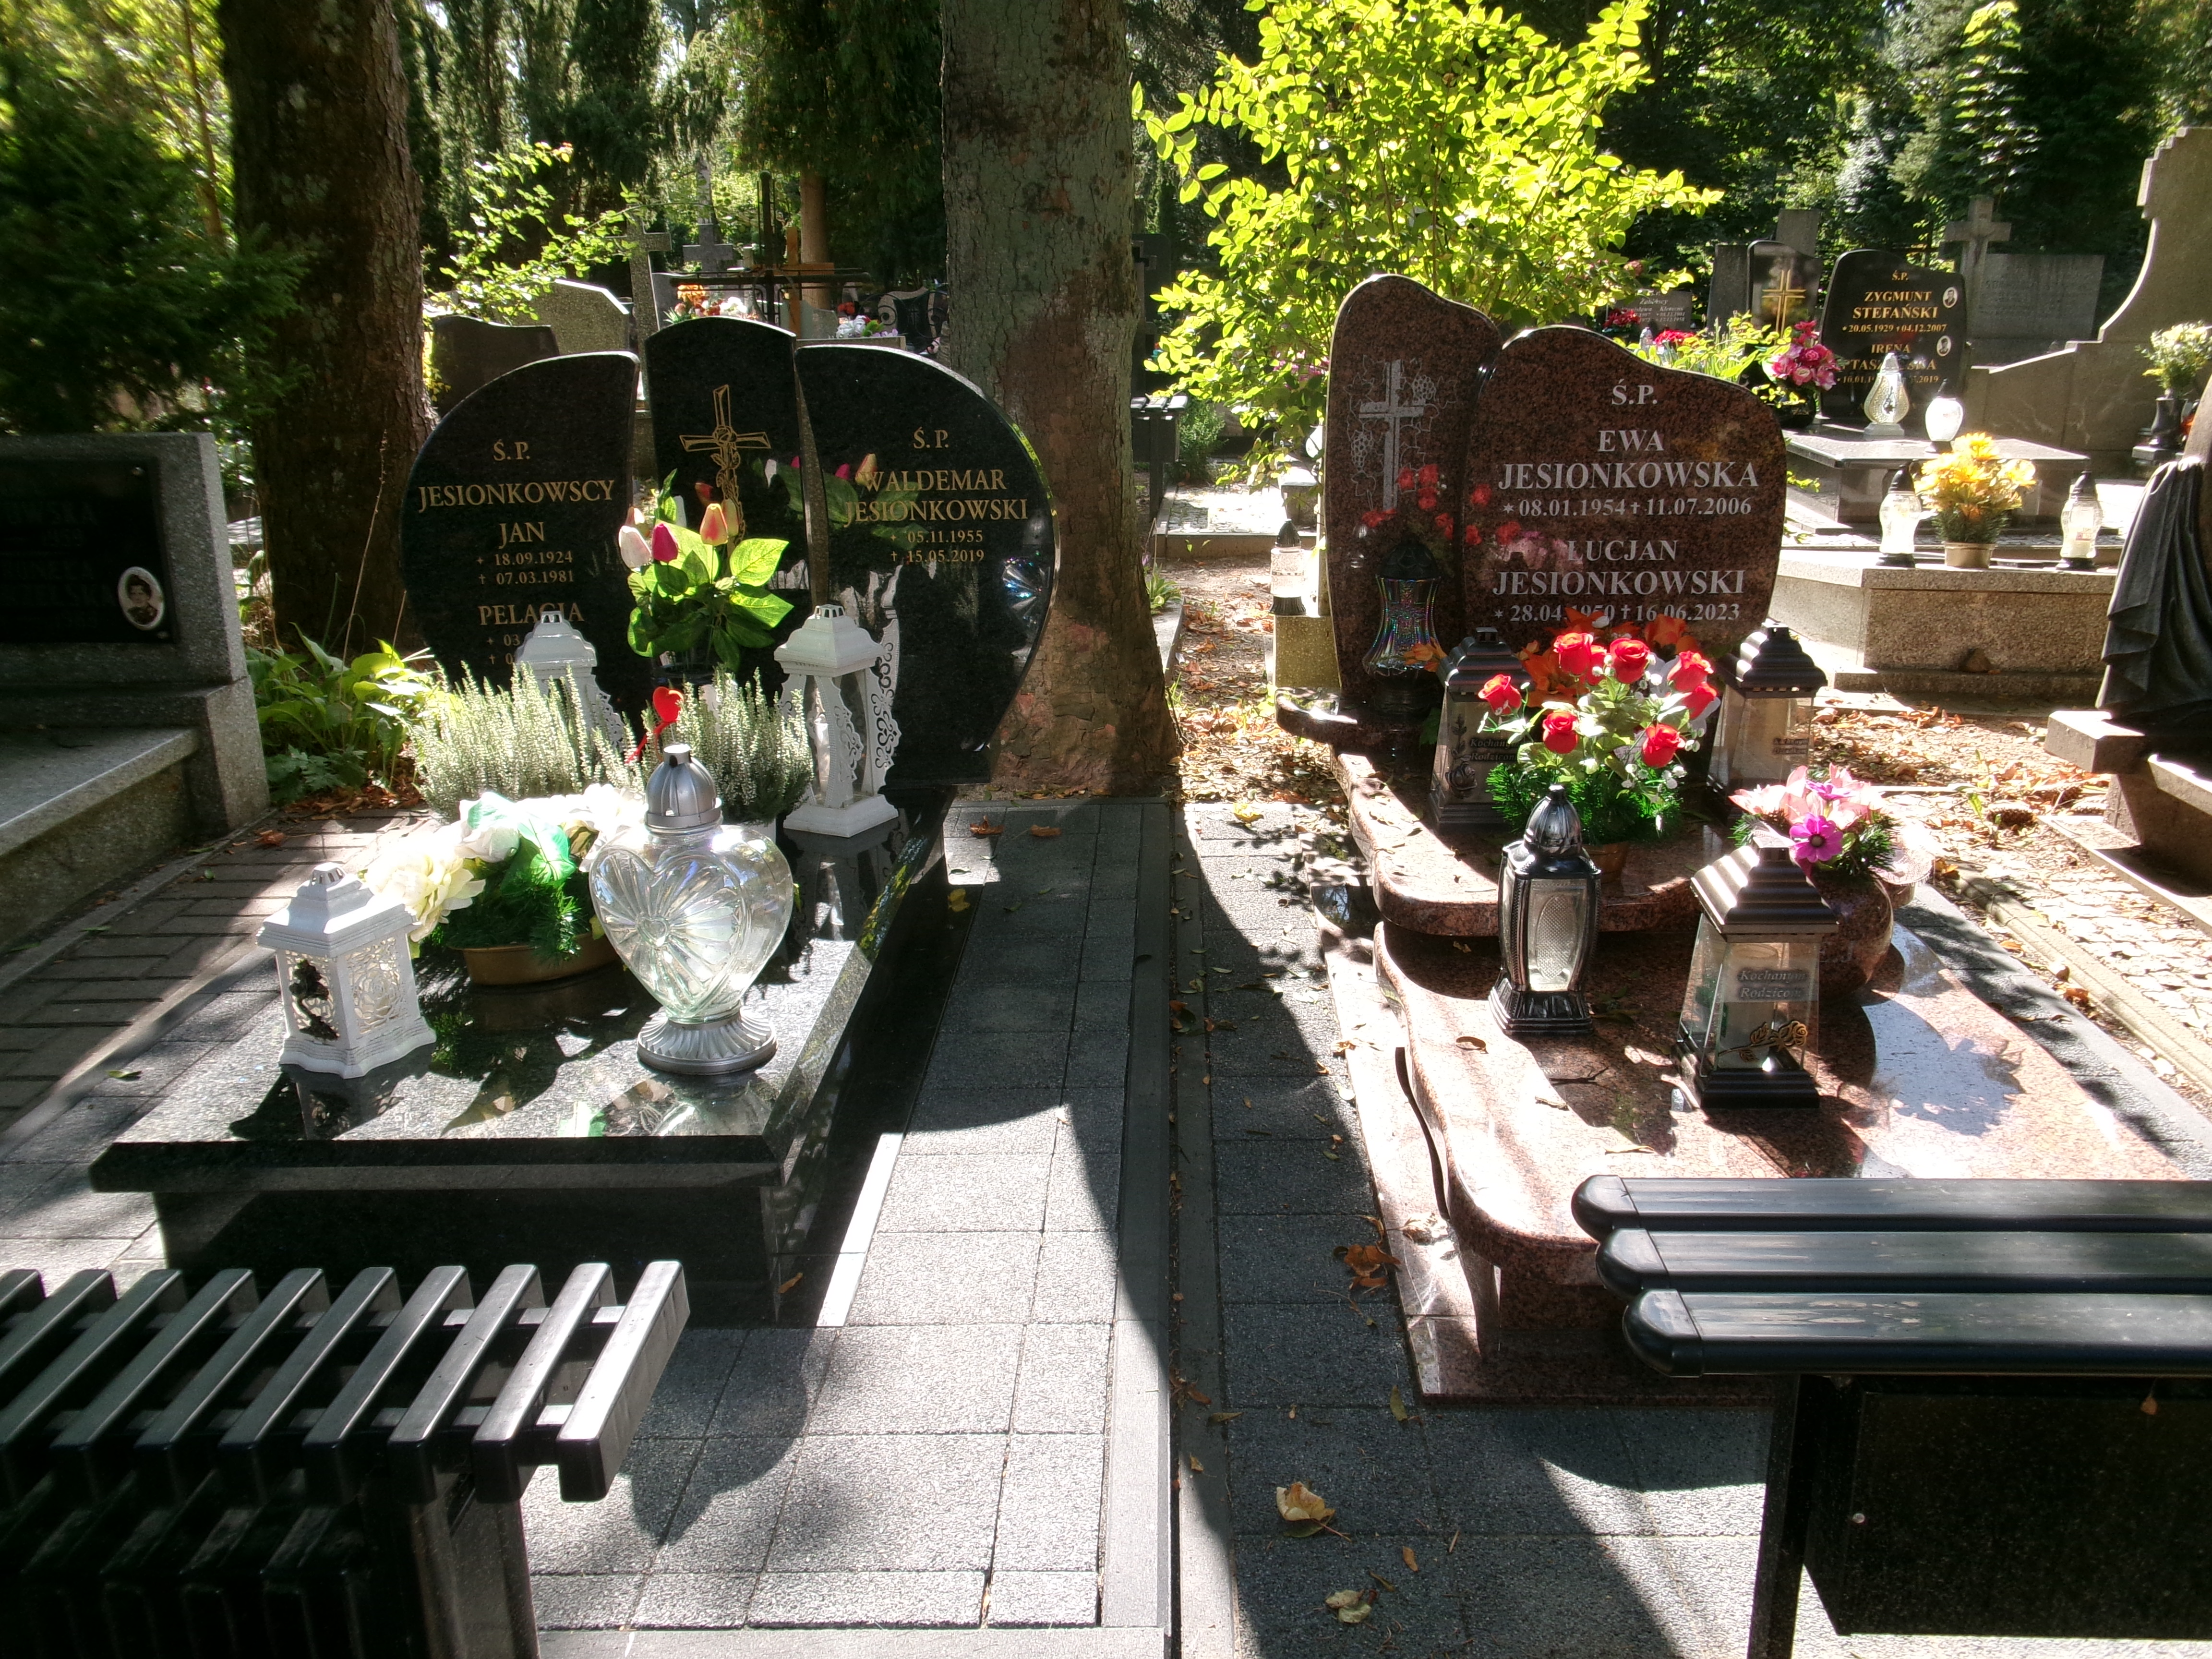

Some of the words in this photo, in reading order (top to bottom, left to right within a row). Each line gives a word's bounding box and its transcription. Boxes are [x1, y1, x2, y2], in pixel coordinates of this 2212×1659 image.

[1864, 291, 1932, 302] ZYGMUNT
[1853, 304, 1938, 319] STEFAŃSKI
[1849, 325, 1894, 333] 20.05.1929
[1901, 324, 1947, 332] 04.12.2007
[1871, 344, 1911, 353] IRENA
[1598, 430, 1664, 452] EWA
[858, 469, 1007, 492] WALDEMAR
[1498, 462, 1759, 490] JESIONKOWSKA
[419, 480, 614, 513] JESIONKOWSCY
[843, 499, 1028, 528] JESIONKOWSKI
[1519, 499, 1626, 517] 08.01.1954
[1647, 497, 1752, 515] 11.07.2006
[499, 522, 544, 549] JAN
[908, 530, 983, 543] 05.11.1955
[494, 551, 573, 565] 18.09.1924
[908, 549, 984, 562] 15.05.2019
[496, 570, 574, 585] 07.03.1981
[1492, 570, 1746, 595] JESIONKOWSKI
